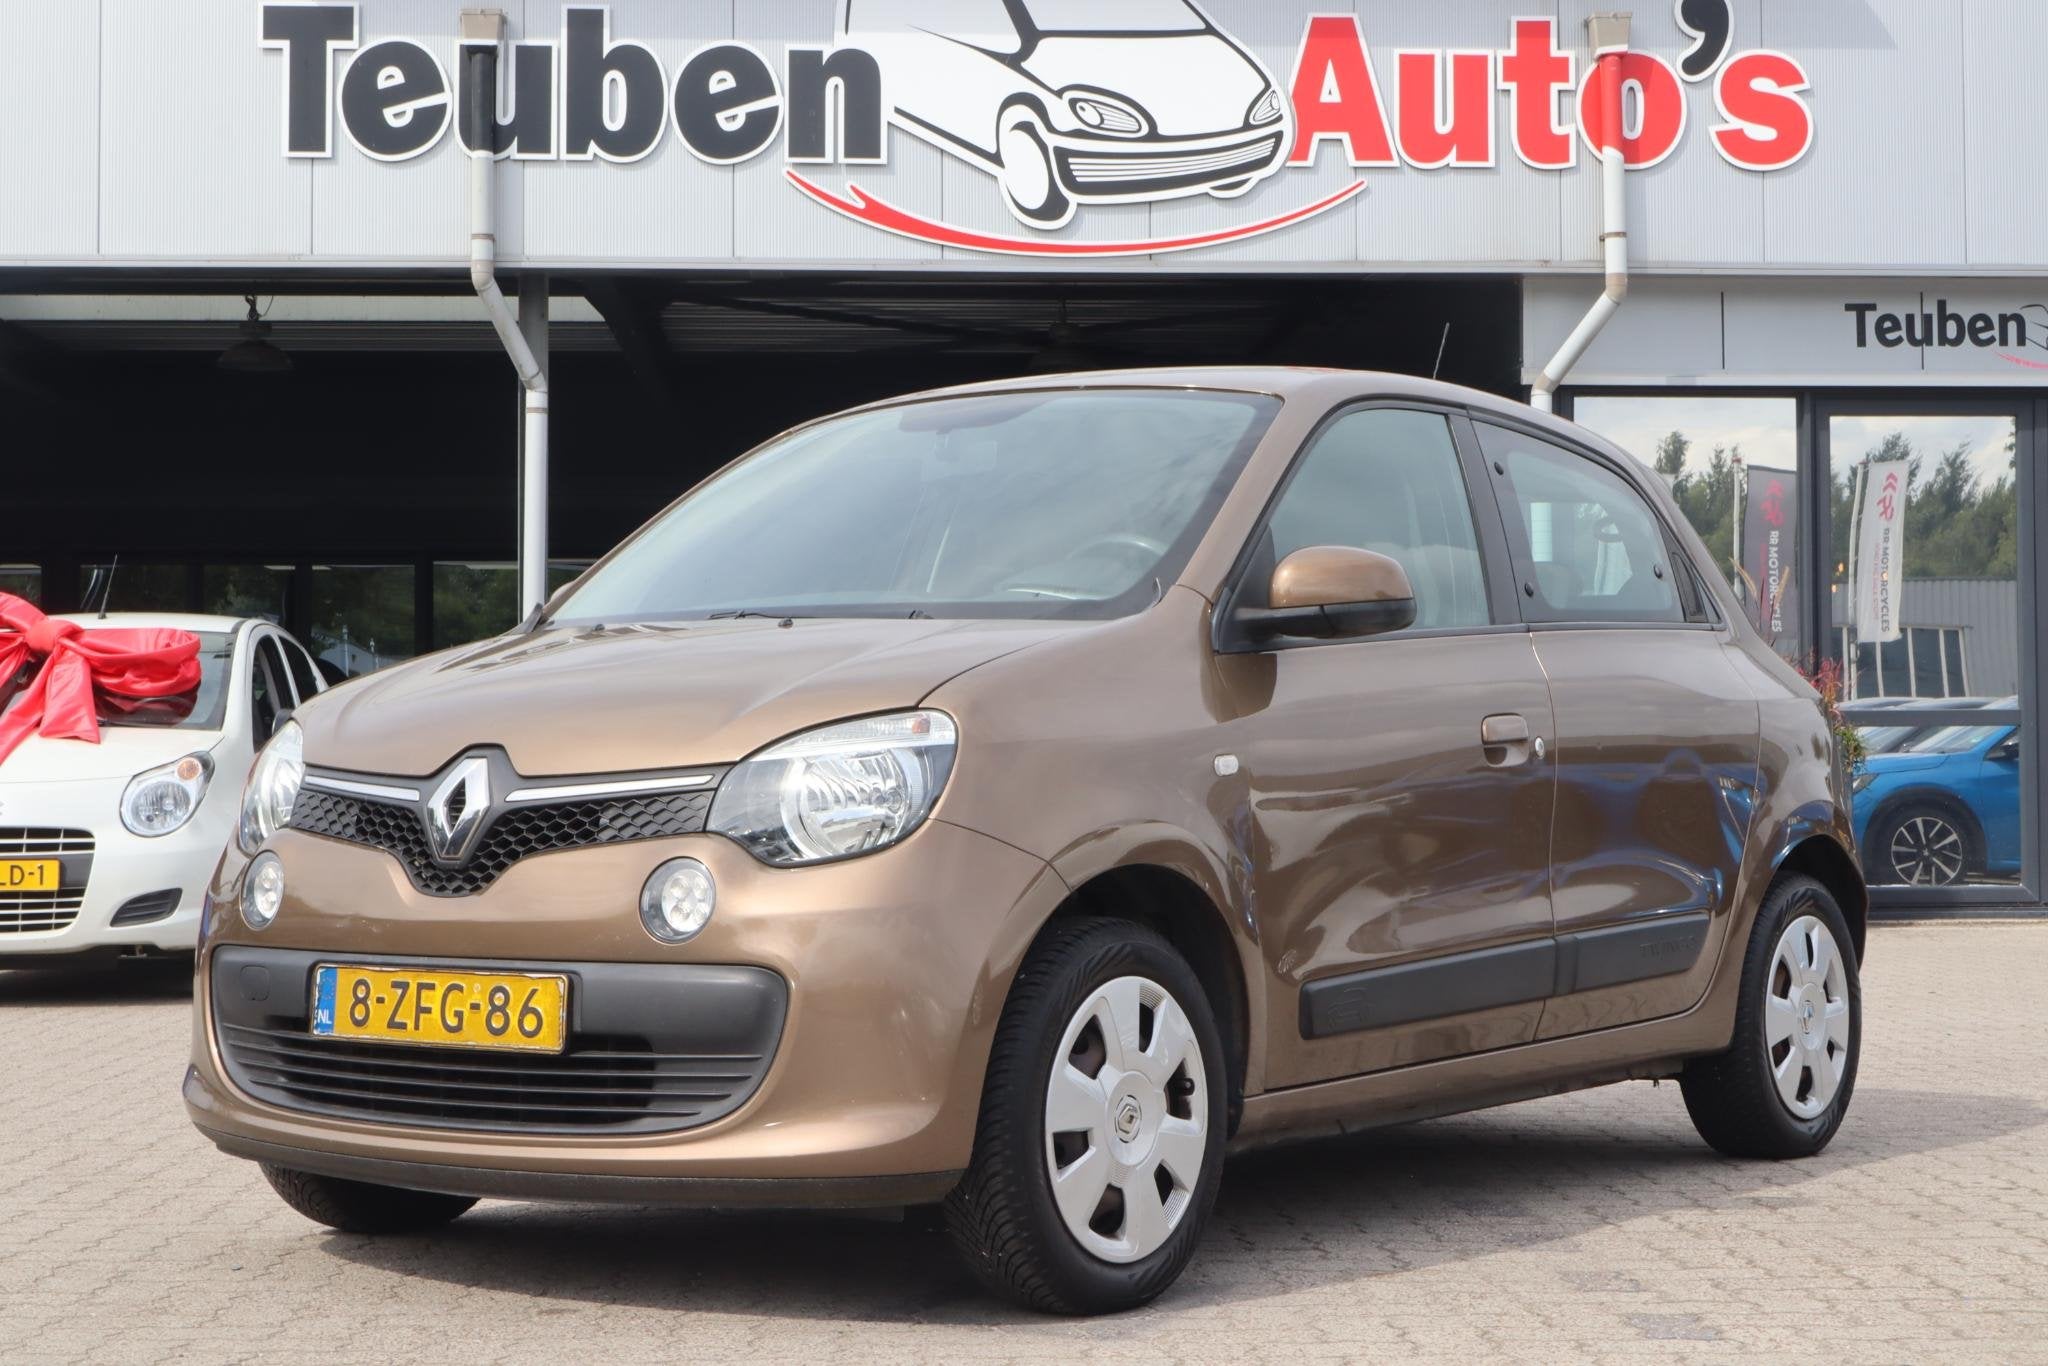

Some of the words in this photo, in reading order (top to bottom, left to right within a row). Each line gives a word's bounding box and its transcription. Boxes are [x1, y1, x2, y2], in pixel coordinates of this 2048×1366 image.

[260, 3, 885, 163] Teuben
[1288, 0, 1814, 169] Auto's
[1844, 299, 2027, 348] Teuben
[1769, 530, 1779, 545] RR
[1880, 546, 1890, 633] MOTORCYCLES
[317, 1008, 332, 1025] NL
[349, 978, 544, 1038] 8-ZFG-86
